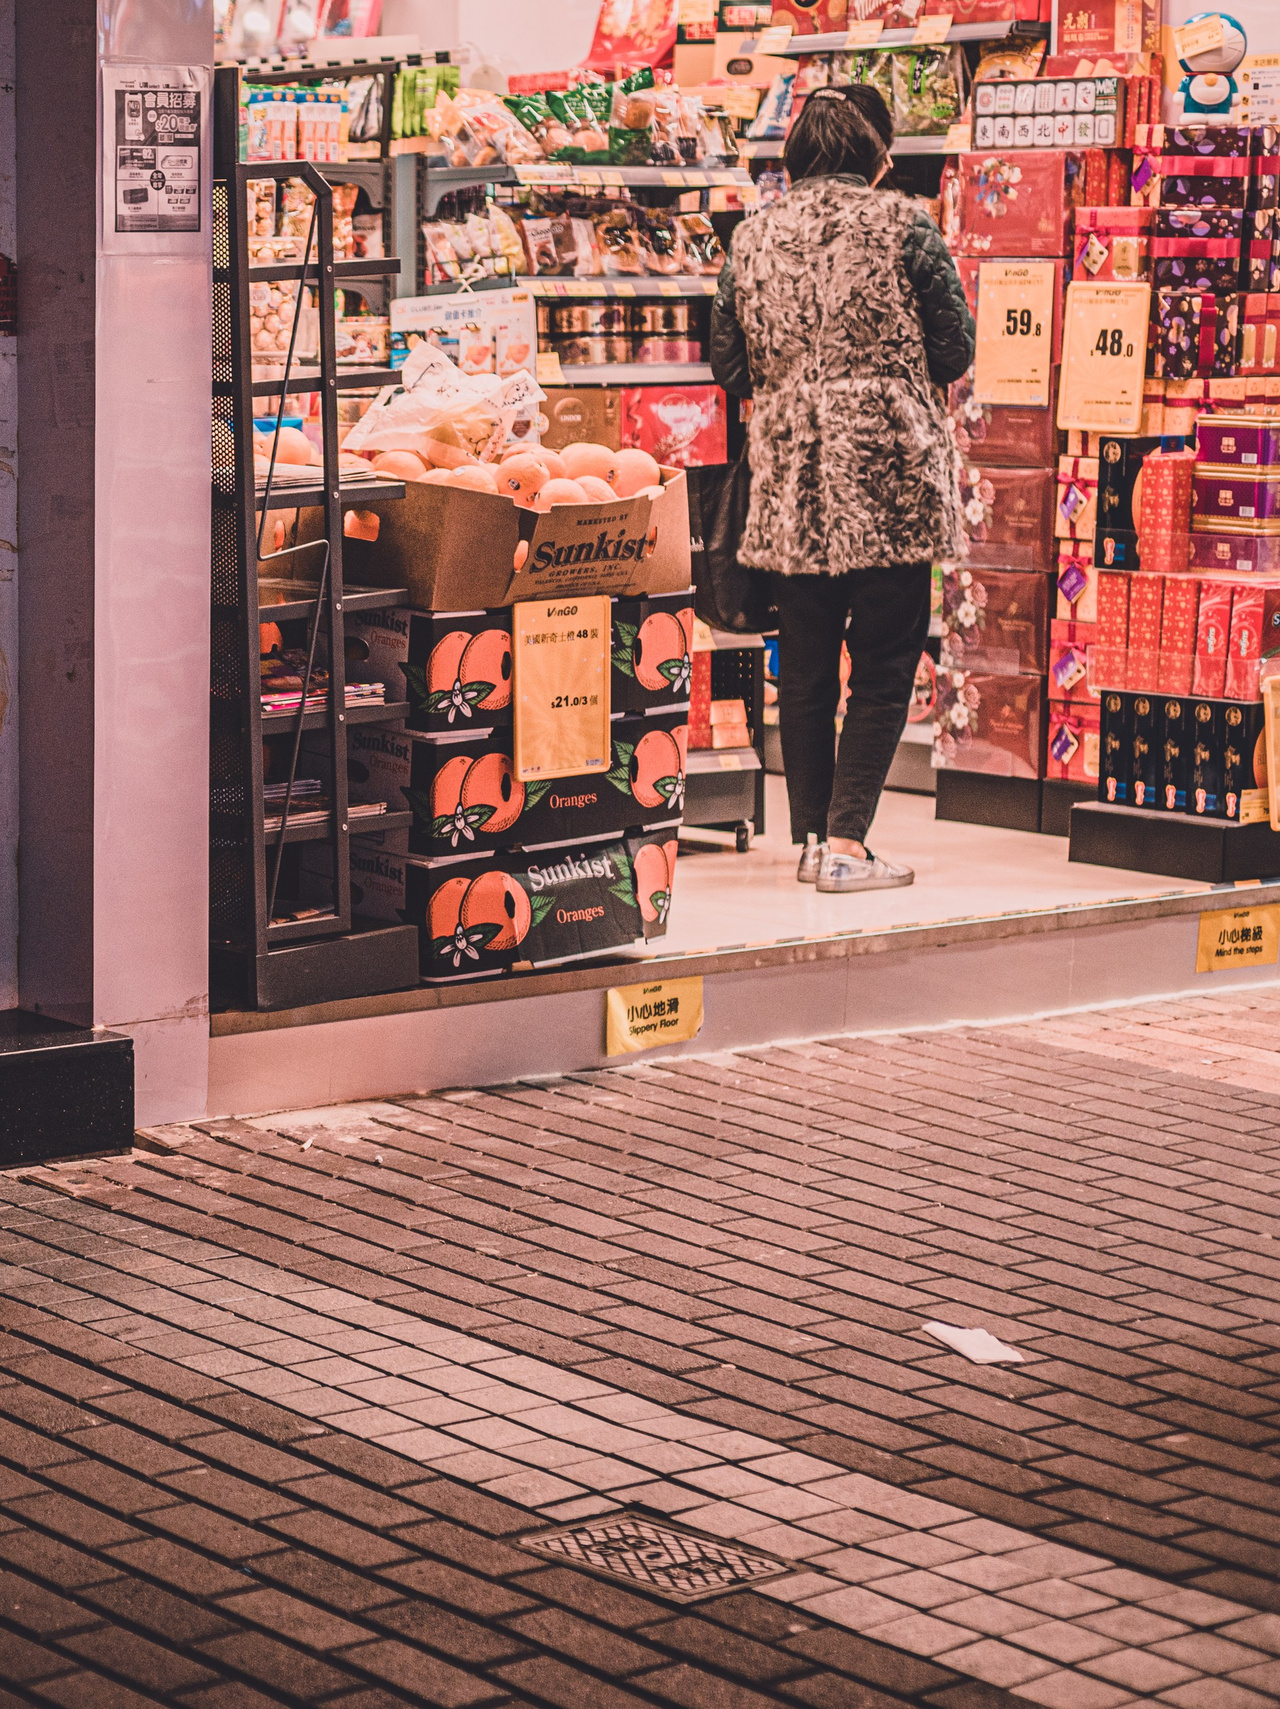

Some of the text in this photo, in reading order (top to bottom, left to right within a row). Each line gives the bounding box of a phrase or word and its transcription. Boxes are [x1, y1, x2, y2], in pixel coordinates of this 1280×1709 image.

[144, 92, 196, 108] 會員招募
[980, 125, 990, 140] 東
[998, 125, 1010, 139] 南
[1018, 125, 1029, 138] 西
[1037, 123, 1050, 137] 北
[1058, 121, 1069, 139] 中
[576, 516, 616, 526] MARKETED
[529, 528, 648, 574] Sunkist
[549, 566, 597, 577] GROWERS,
[355, 609, 407, 637] Sunkist
[370, 630, 406, 650] Oranges
[524, 631, 575, 646] 美國新奇士橙
[576, 629, 588, 639] 48
[352, 731, 410, 762] Sunkist
[369, 755, 409, 775] Oranges
[549, 792, 598, 809] Oranges
[349, 852, 404, 885] Sunkist
[527, 853, 616, 892] Sunkist
[364, 873, 404, 897] Oranges
[556, 905, 605, 924] Oranges
[1218, 925, 1262, 945] 小心梯級
[1215, 945, 1263, 957] Mind the steps
[627, 997, 679, 1023] 小心地滑
[629, 1018, 679, 1036] Slippery Floor
